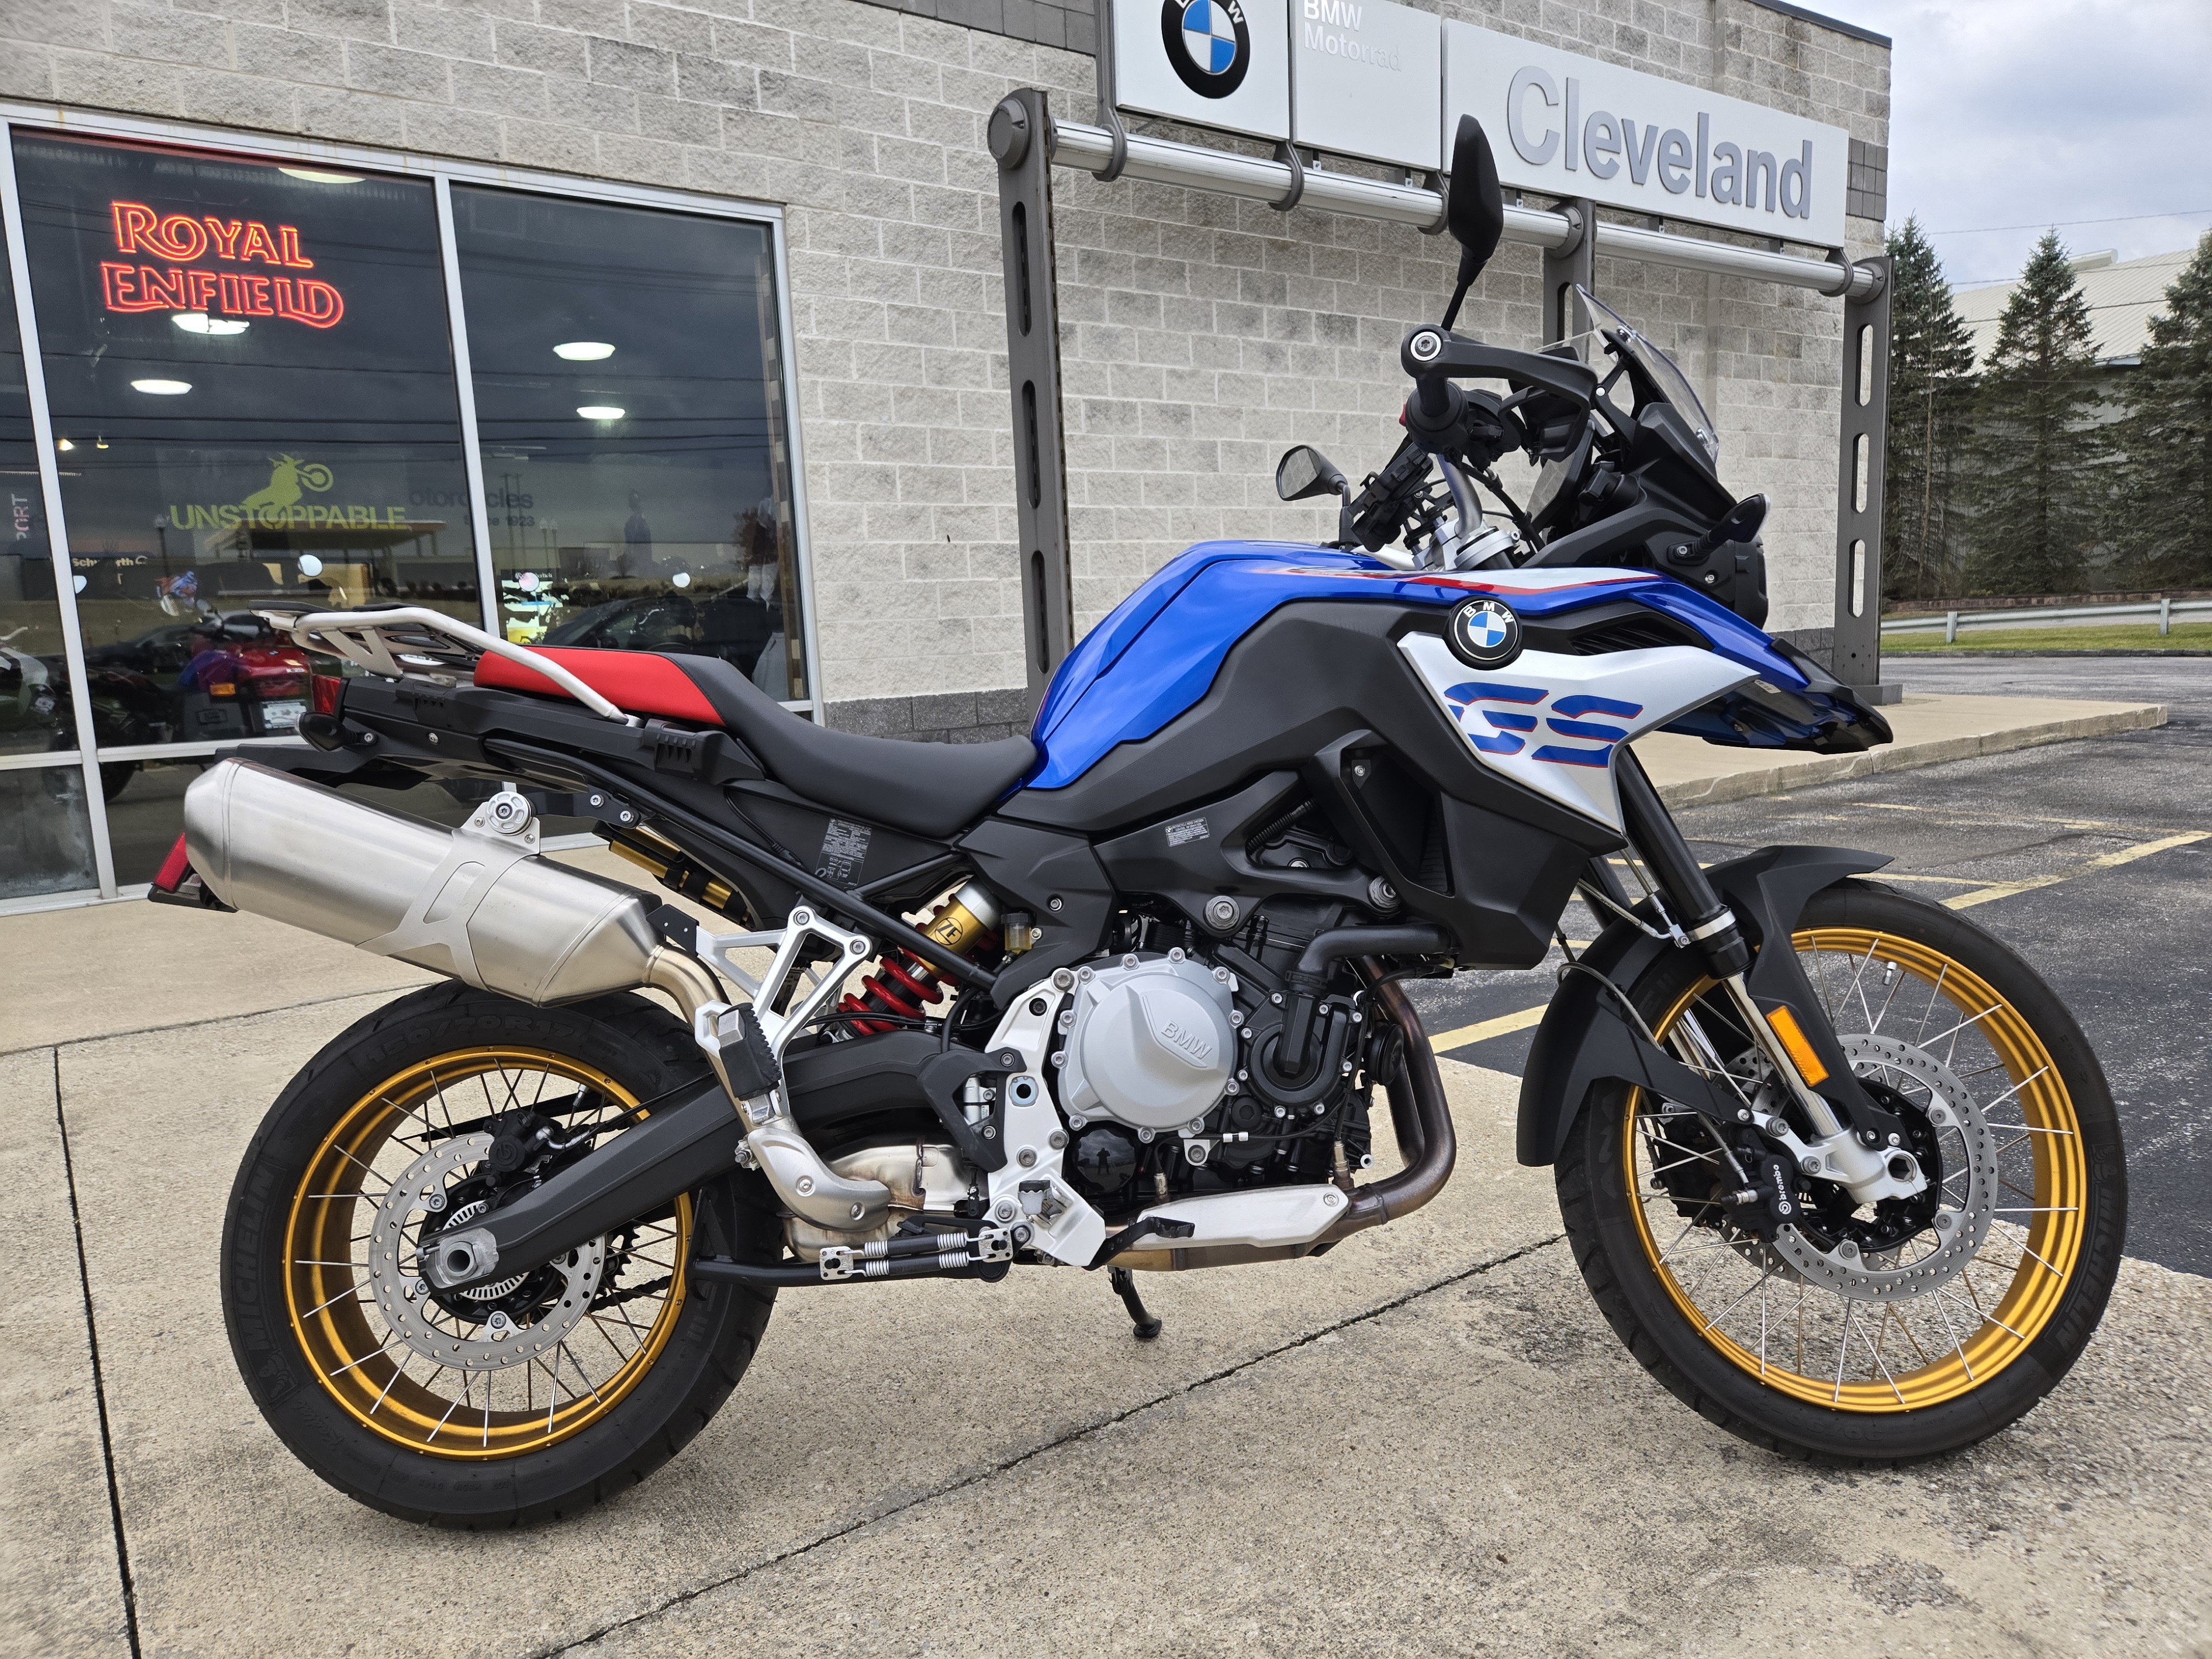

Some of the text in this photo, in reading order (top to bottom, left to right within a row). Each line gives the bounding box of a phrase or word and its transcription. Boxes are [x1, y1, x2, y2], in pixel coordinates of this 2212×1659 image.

[1304, 0, 1362, 31] BMW
[1305, 22, 1401, 72] Motorrad
[1506, 65, 1813, 220] Cleveland
[112, 201, 314, 269] ROYAL
[101, 261, 345, 329] ENFIELD
[170, 504, 408, 530] UNSTOPPABLE
[1463, 601, 1514, 623] BMW
[1444, 681, 1643, 769] GS
[1161, 1019, 1212, 1060] BMW
[1773, 1164, 1787, 1201] brembo
